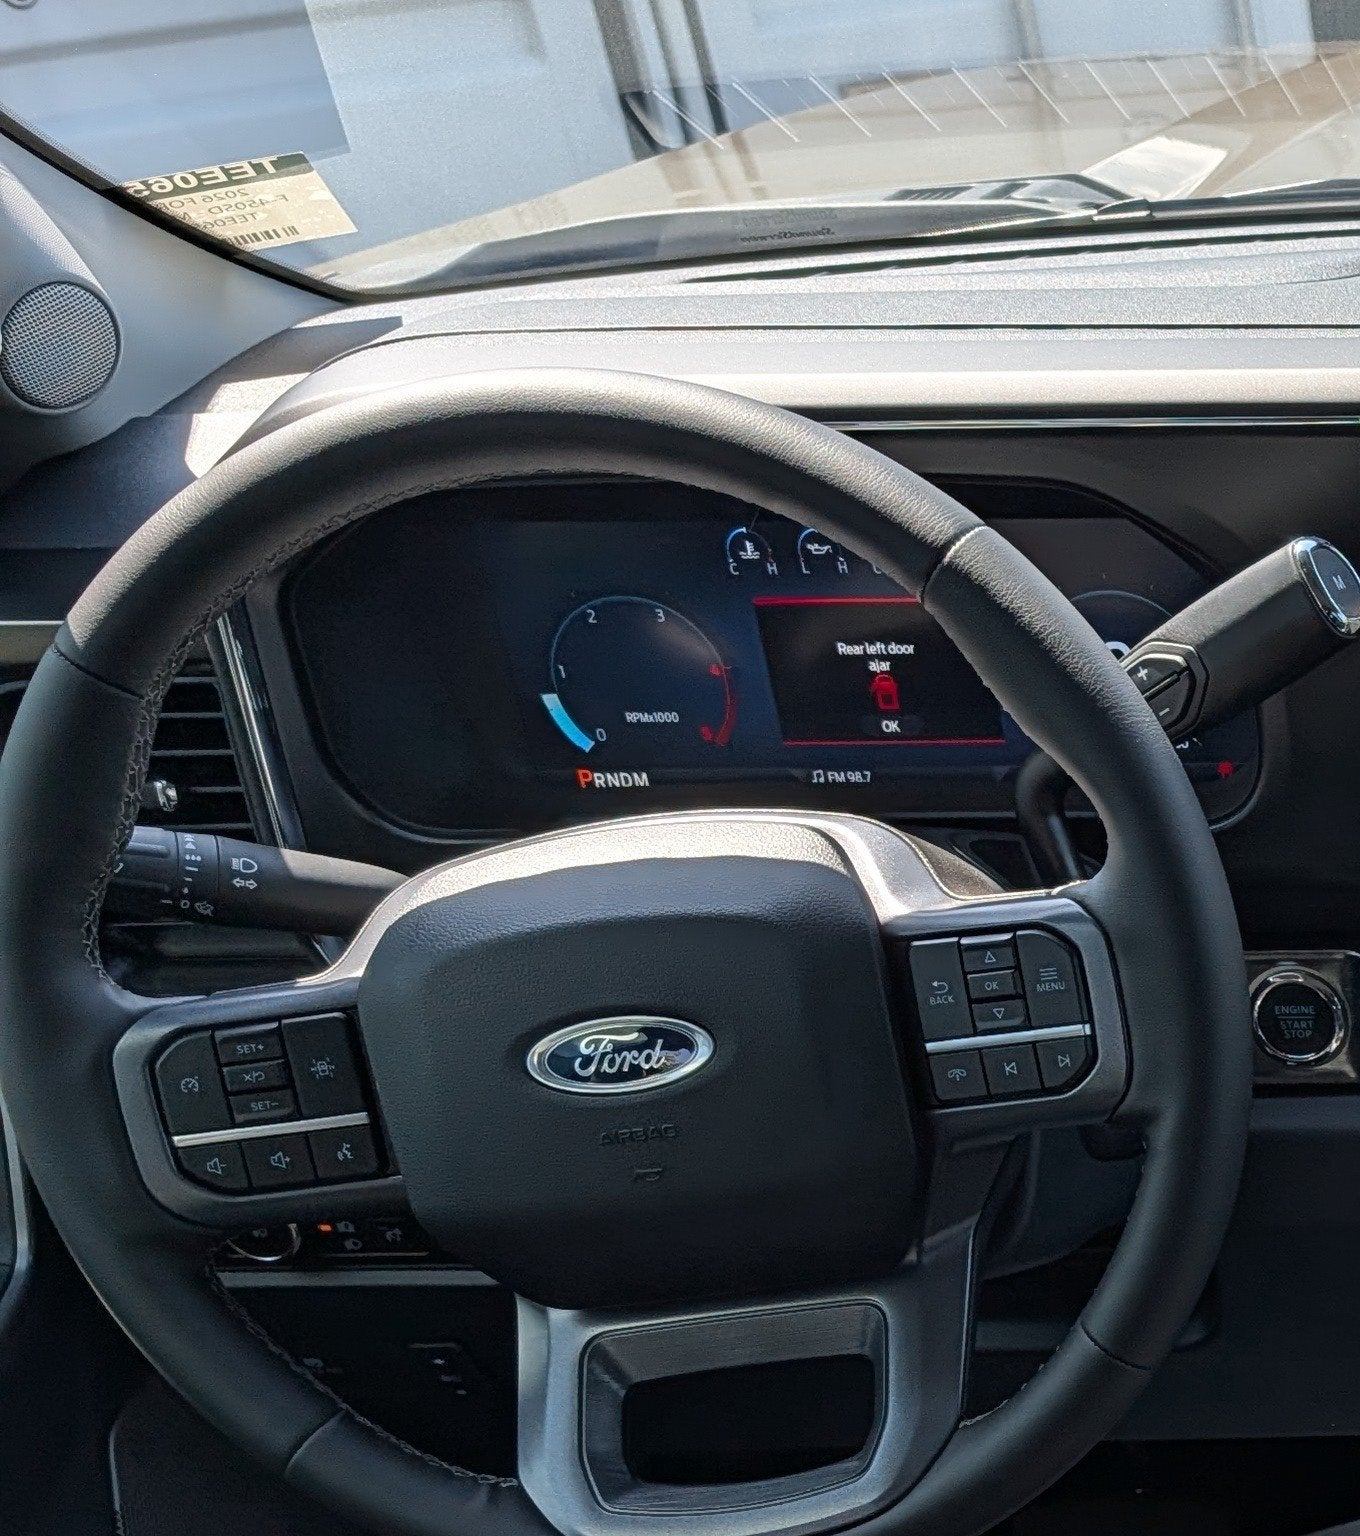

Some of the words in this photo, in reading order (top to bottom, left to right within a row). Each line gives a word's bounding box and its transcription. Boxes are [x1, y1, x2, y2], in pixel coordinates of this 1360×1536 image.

[767, 562, 779, 575] H
[801, 561, 811, 574] L
[837, 561, 849, 574] H
[587, 609, 598, 623] 2
[655, 609, 666, 623] 3
[836, 642, 864, 655] Rear
[866, 642, 886, 655] left
[887, 642, 915, 655] door
[558, 664, 566, 678] 1
[868, 659, 891, 672] ajar
[624, 711, 680, 724] RPMx1000
[881, 720, 901, 733] OK
[827, 770, 846, 783] FM
[846, 770, 871, 783] 98.7
[984, 981, 999, 992] OK
[1036, 982, 1066, 993] MENU
[929, 995, 955, 1006] BACK
[1274, 1005, 1316, 1014] ENGINE
[1280, 1020, 1314, 1030] START
[1284, 1029, 1313, 1039] STOP
[574, 1032, 665, 1077] Ford
